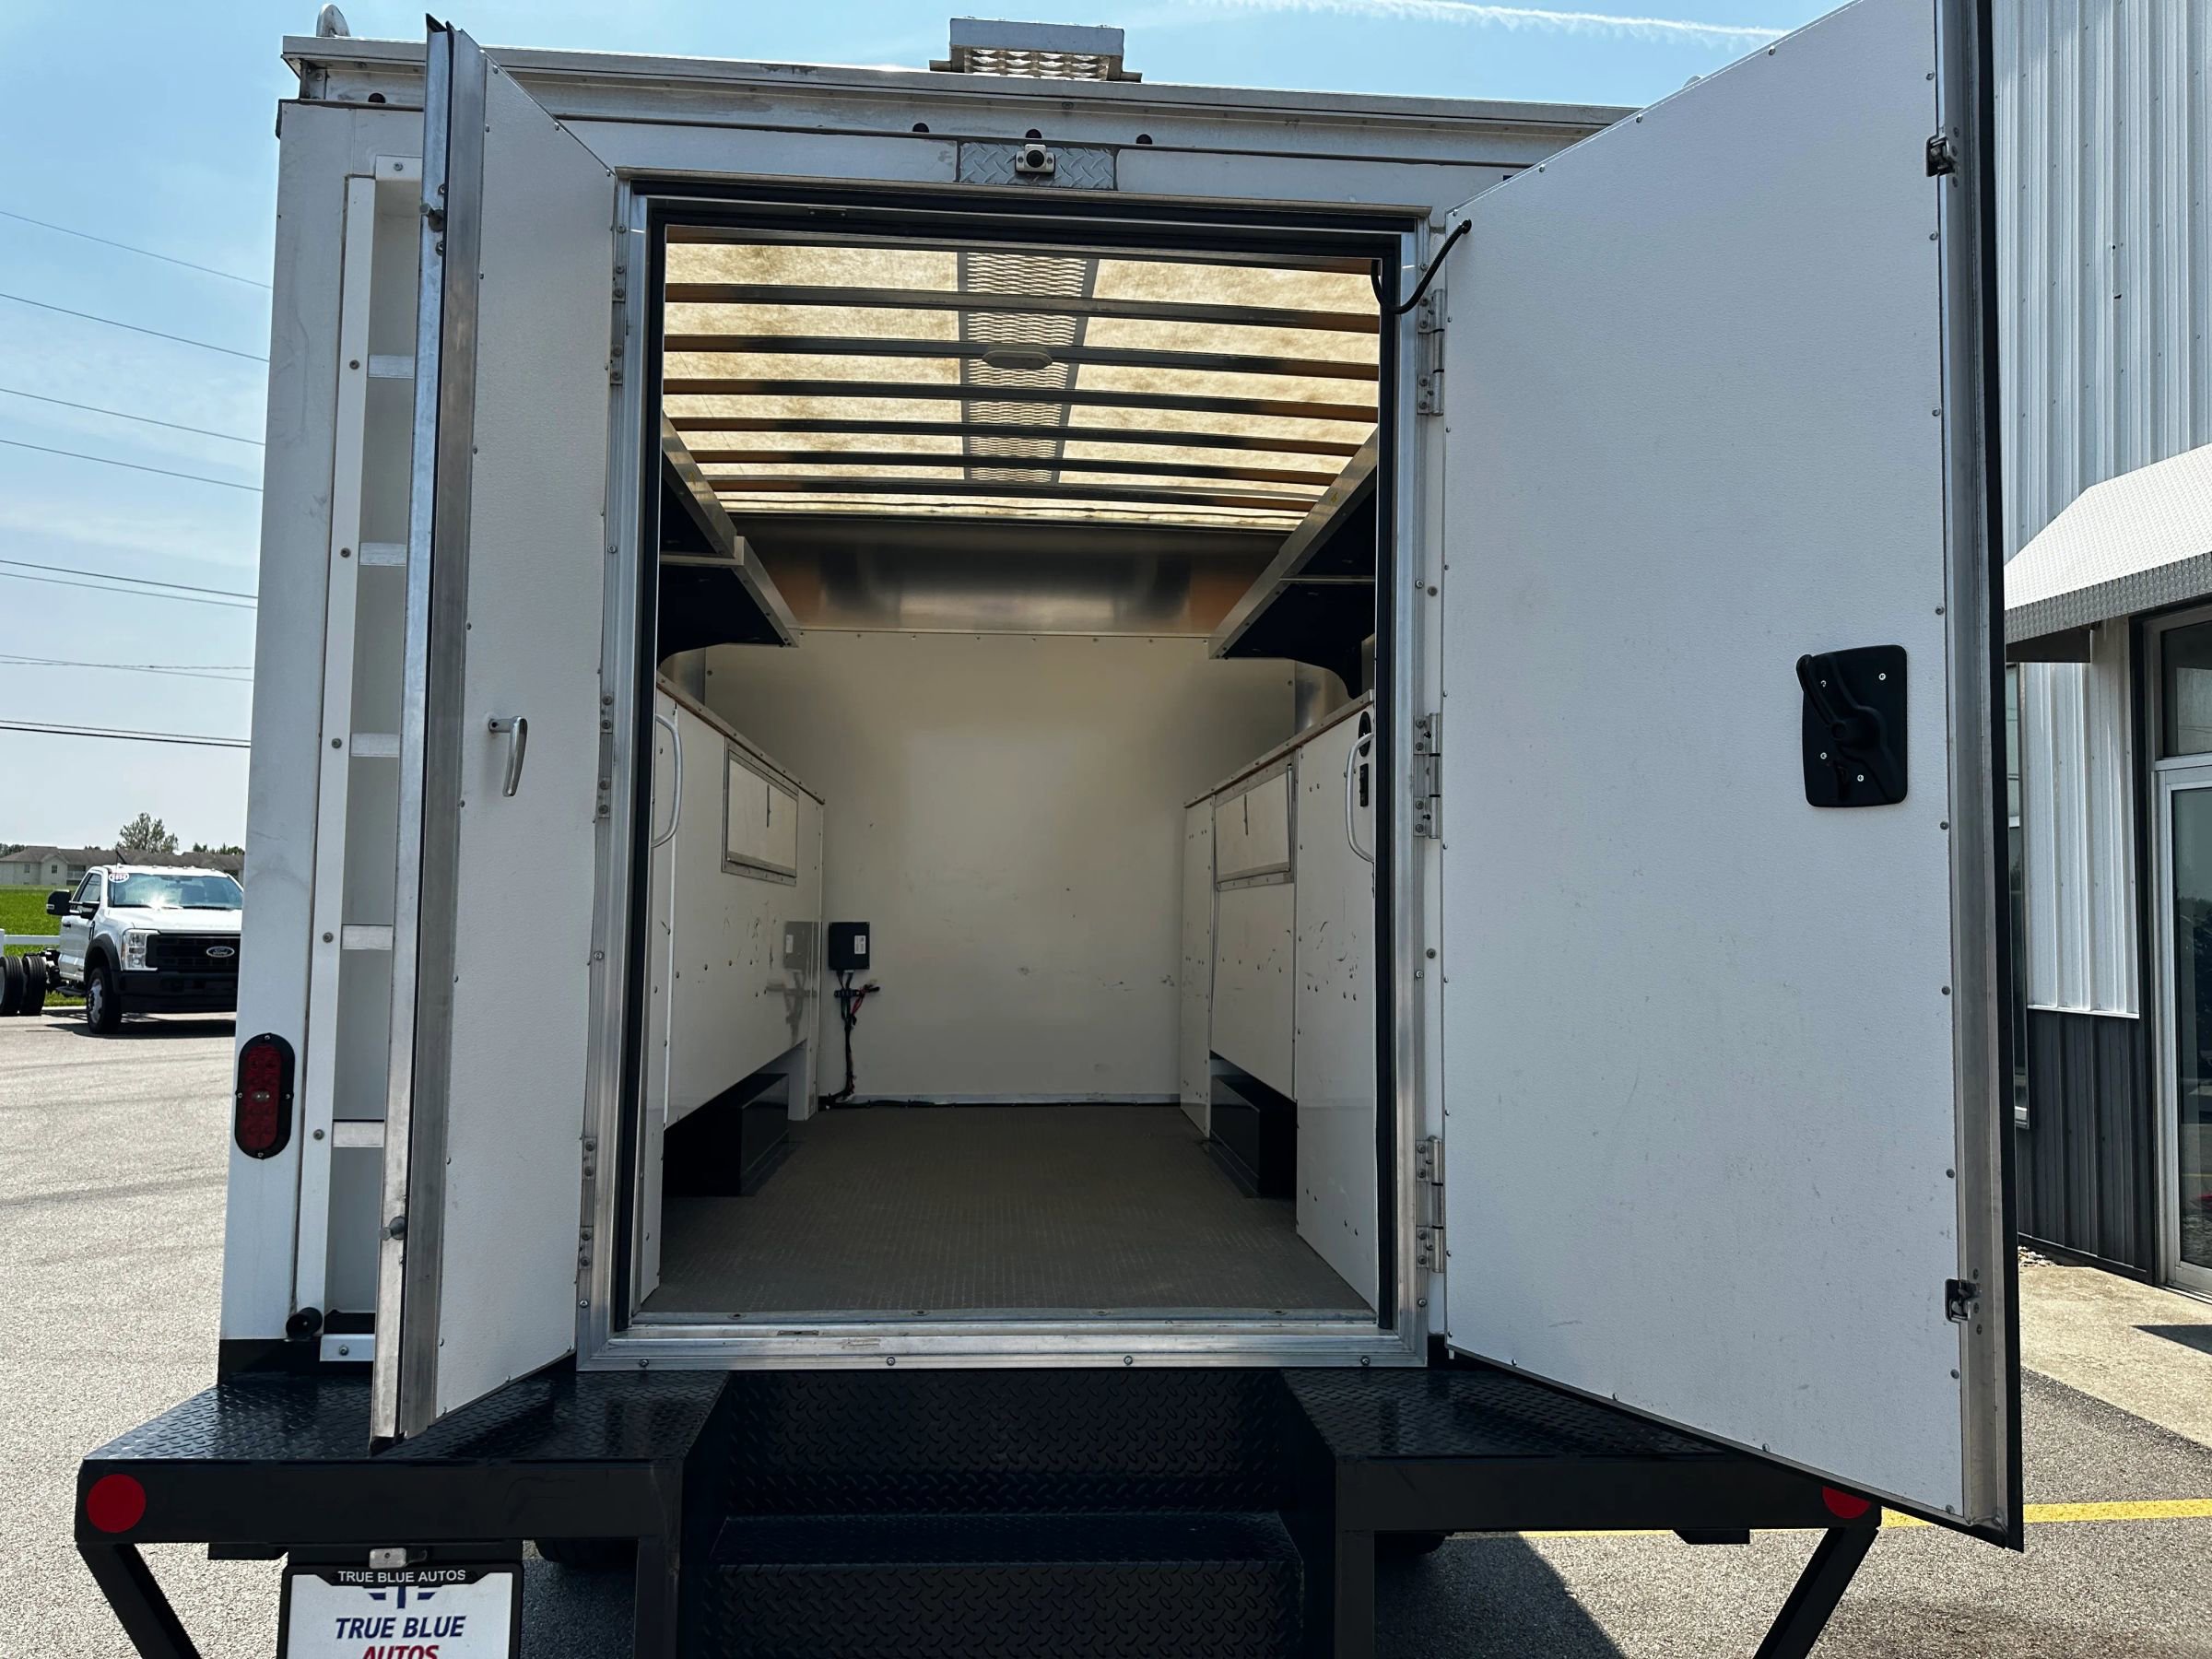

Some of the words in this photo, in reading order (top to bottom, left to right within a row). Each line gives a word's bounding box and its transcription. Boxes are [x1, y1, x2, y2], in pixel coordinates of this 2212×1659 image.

[337, 1571, 374, 1583] TRUE
[377, 1571, 415, 1583] BLUE
[418, 1570, 466, 1583] AUTOS
[335, 1617, 397, 1639] TRUE
[402, 1615, 466, 1638] BLUE
[362, 1644, 440, 1659] AUTOS
